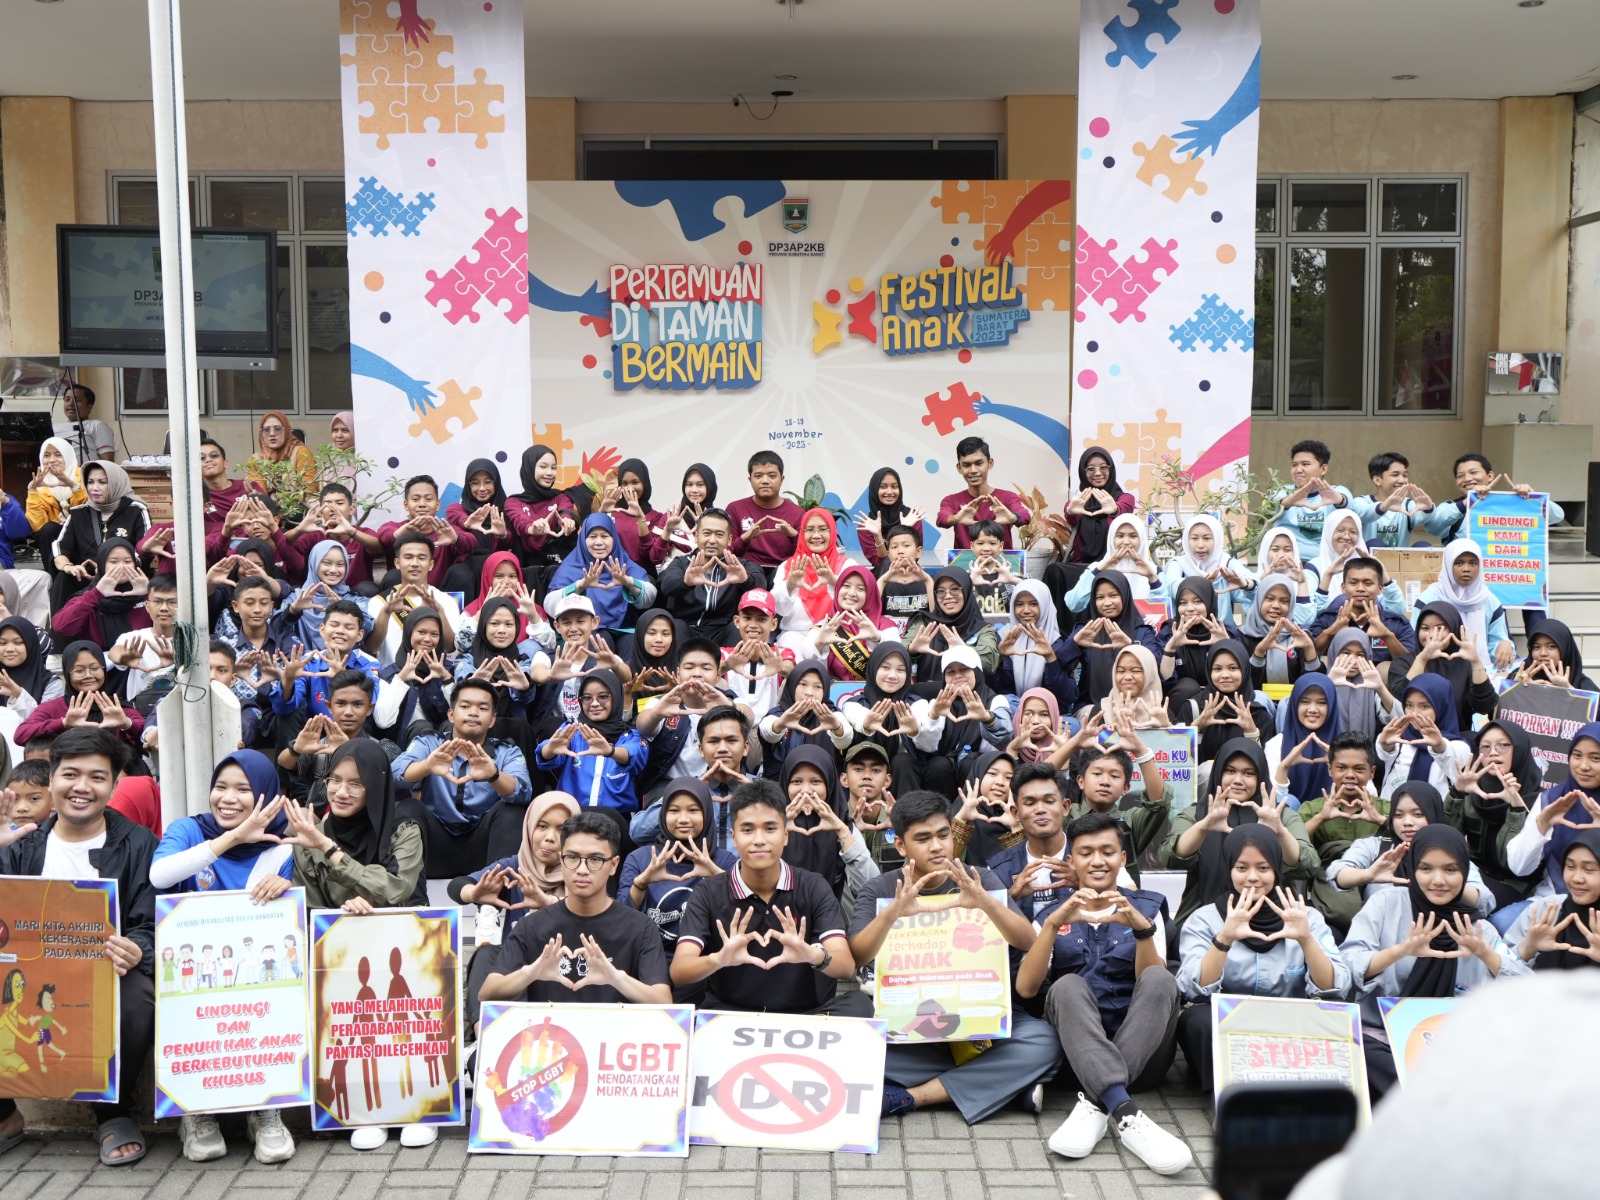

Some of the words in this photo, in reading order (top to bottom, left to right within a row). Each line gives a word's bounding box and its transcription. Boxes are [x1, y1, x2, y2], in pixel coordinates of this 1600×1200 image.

[769, 243, 825, 252] DP3AP2KB
[650, 297, 753, 341] TAMAN
[976, 309, 1027, 323] SUMATERA
[977, 321, 1009, 332] BARAT
[975, 331, 1004, 342] 2023
[768, 429, 823, 440] November
[1482, 516, 1534, 527] LINDUNGI
[1494, 531, 1522, 541] KAMI
[1494, 545, 1521, 555] DARI
[1483, 559, 1541, 569] EKERASAN
[1171, 750, 1188, 763] KU
[1172, 768, 1192, 781] MU
[14, 919, 41, 931] MARI
[43, 921, 66, 932] KITA
[68, 922, 105, 933] AKHIRI
[40, 933, 106, 945] KEKERASAN
[888, 940, 948, 952] terhadap
[44, 947, 73, 959] PADA
[74, 948, 105, 960] ANAK
[888, 952, 953, 971] ANAK
[888, 975, 917, 984] Dampak
[919, 973, 954, 982] Kekerasan
[955, 973, 974, 981] pada
[975, 971, 993, 980] Anak
[196, 1001, 270, 1019] LINDUNGI
[331, 1000, 362, 1015] YANG
[364, 997, 443, 1014] MELAHIRKAN
[217, 1020, 250, 1035] DAN
[331, 1021, 402, 1038] PERADABAN
[404, 1019, 442, 1035] TIDAK
[732, 1027, 842, 1050] STOP
[163, 1040, 222, 1058] PENUHI
[224, 1037, 257, 1052] HAK
[258, 1033, 303, 1049] ANAK
[326, 1044, 372, 1060] PANTAS
[374, 1041, 449, 1058] DILECEHKAN
[171, 1051, 296, 1075] BERKEBUTUHAN
[598, 1042, 681, 1072] LGBT
[202, 1071, 266, 1089] KHUSUS
[511, 1079, 537, 1102] STOP
[539, 1062, 565, 1086] LGBT
[597, 1073, 680, 1085] MENDATANGKAN
[596, 1086, 638, 1097] MURKA
[641, 1086, 679, 1098] ALLAH
[692, 1075, 874, 1115] KDRT
